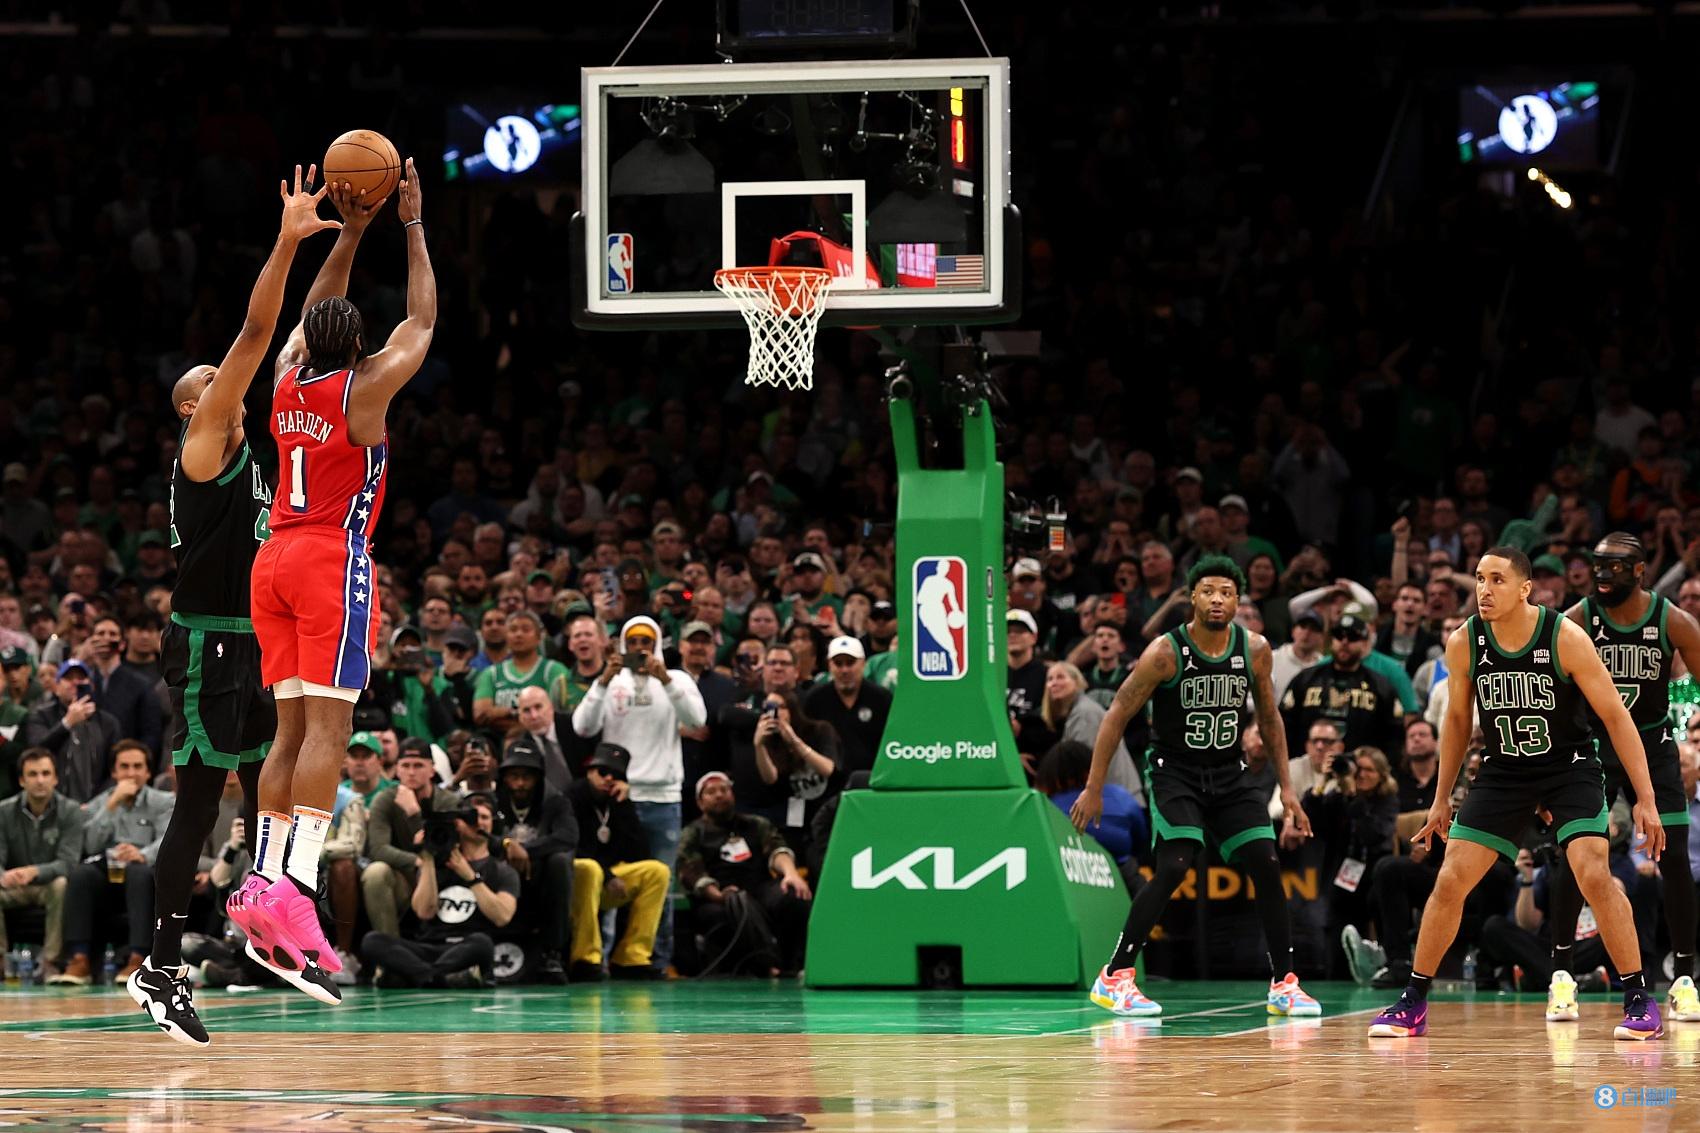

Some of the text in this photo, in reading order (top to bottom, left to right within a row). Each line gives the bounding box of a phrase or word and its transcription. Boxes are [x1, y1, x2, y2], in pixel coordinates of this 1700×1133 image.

[277, 410, 334, 444] HARDEN
[289, 445, 308, 511] 1
[1592, 616, 1600, 626] 6
[1182, 646, 1190, 656] 6
[1478, 635, 1486, 646] 6
[921, 652, 948, 672] NBA
[1533, 649, 1550, 658] VISTA
[1181, 674, 1248, 709] CELTICS
[1477, 672, 1556, 710] CELTICS
[1185, 710, 1239, 749] 36
[1495, 715, 1552, 757] 13
[885, 741, 997, 764] Google Pixel
[439, 898, 476, 913] TNT
